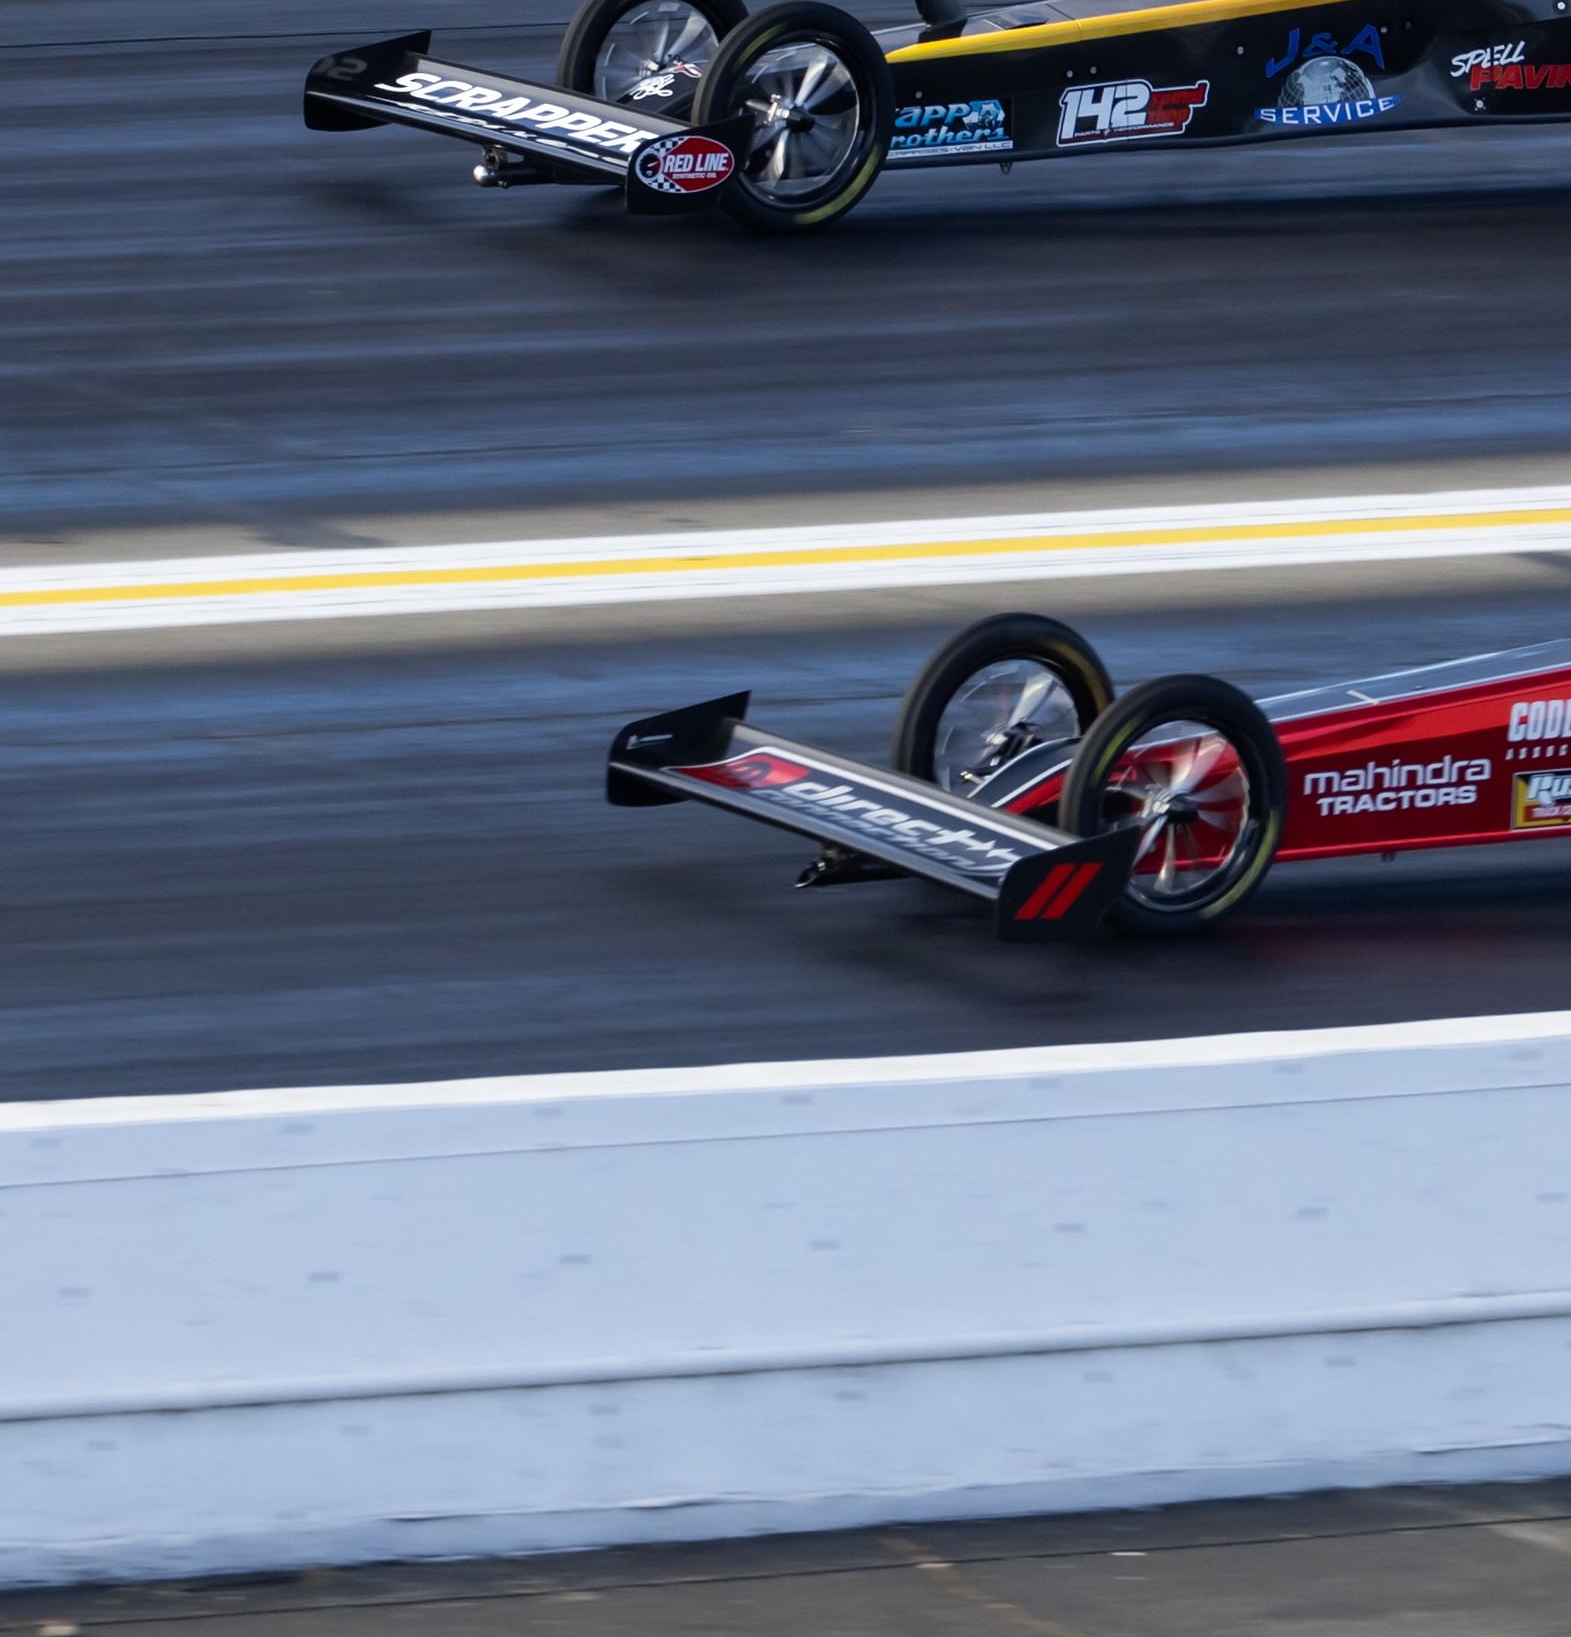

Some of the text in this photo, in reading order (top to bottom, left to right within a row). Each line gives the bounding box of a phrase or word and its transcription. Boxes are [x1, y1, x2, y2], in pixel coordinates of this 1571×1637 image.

[1266, 24, 1386, 79] J&A
[1060, 82, 1151, 140] 142
[1260, 97, 1397, 125] SERVICE
[664, 153, 729, 173] RED LINE
[1304, 756, 1491, 796] mahindra
[1317, 785, 1478, 816] TRACTORS
